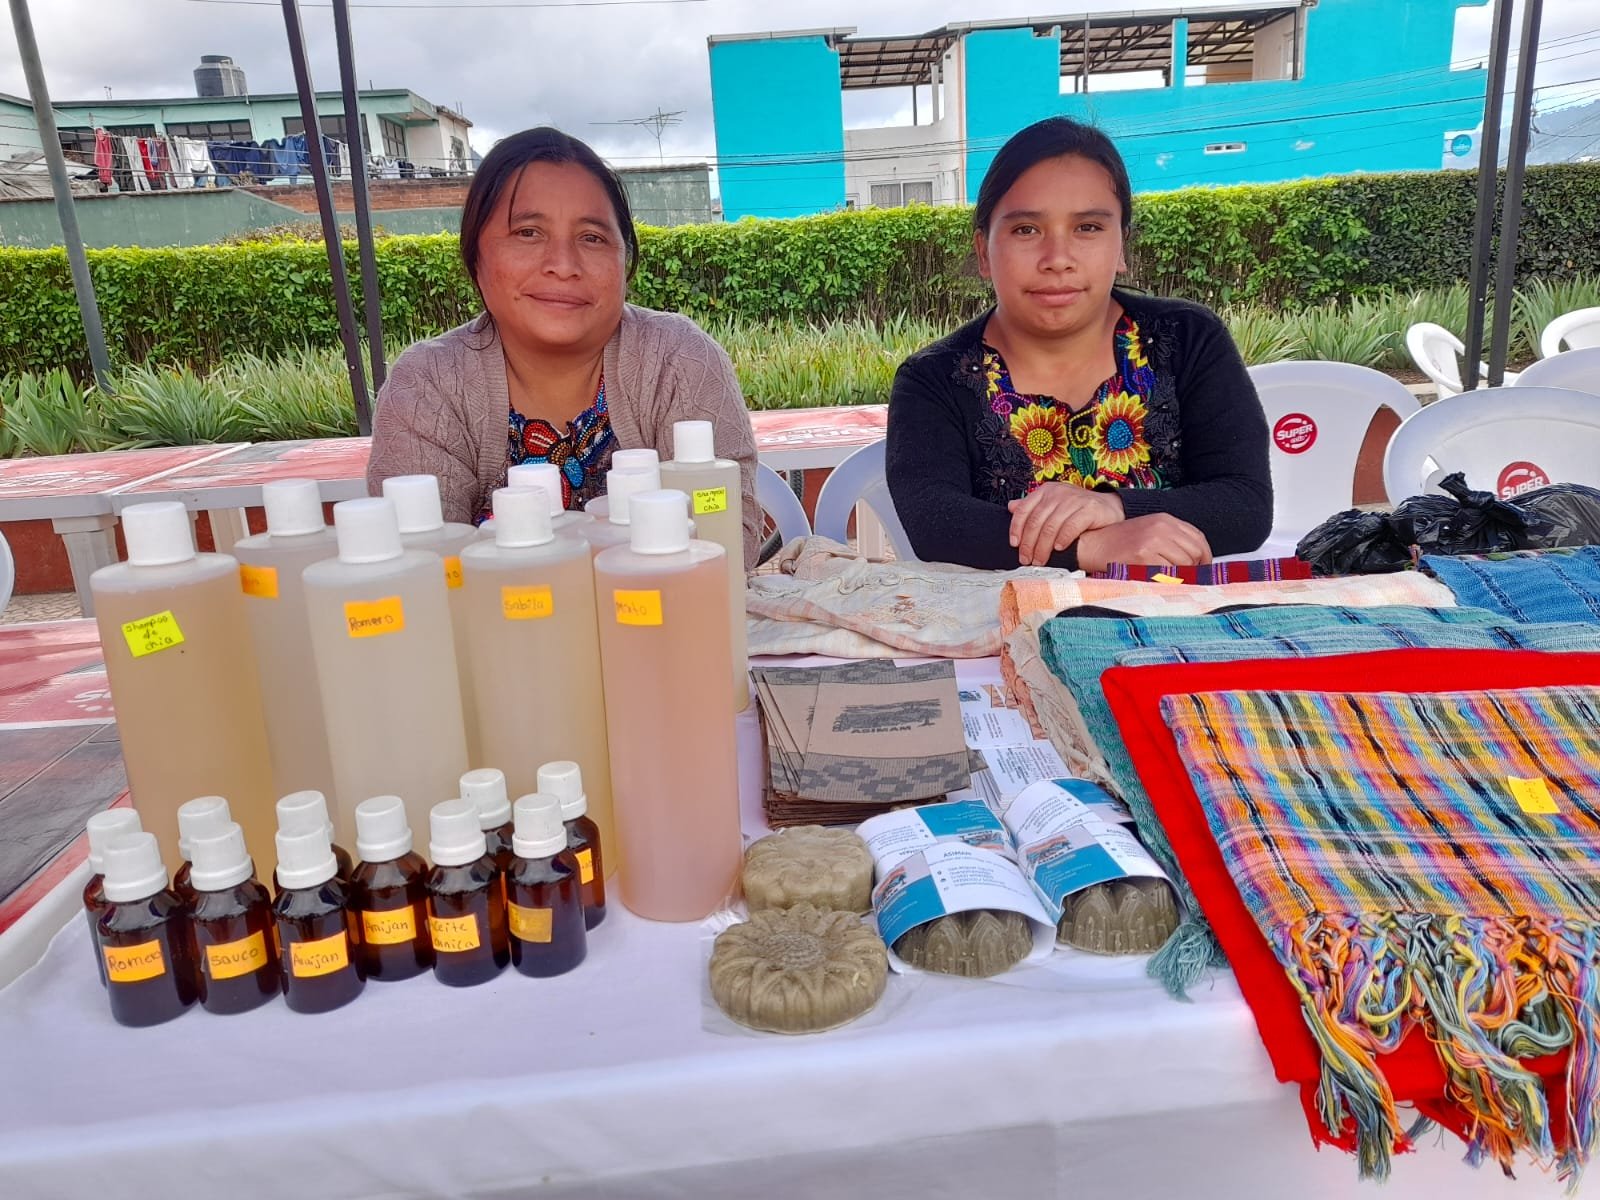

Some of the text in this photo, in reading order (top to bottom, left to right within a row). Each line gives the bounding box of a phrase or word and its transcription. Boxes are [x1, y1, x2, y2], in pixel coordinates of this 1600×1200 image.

[1276, 424, 1313, 441] SUPER
[1501, 476, 1545, 501] SUPER
[851, 725, 912, 734] ASIMAM
